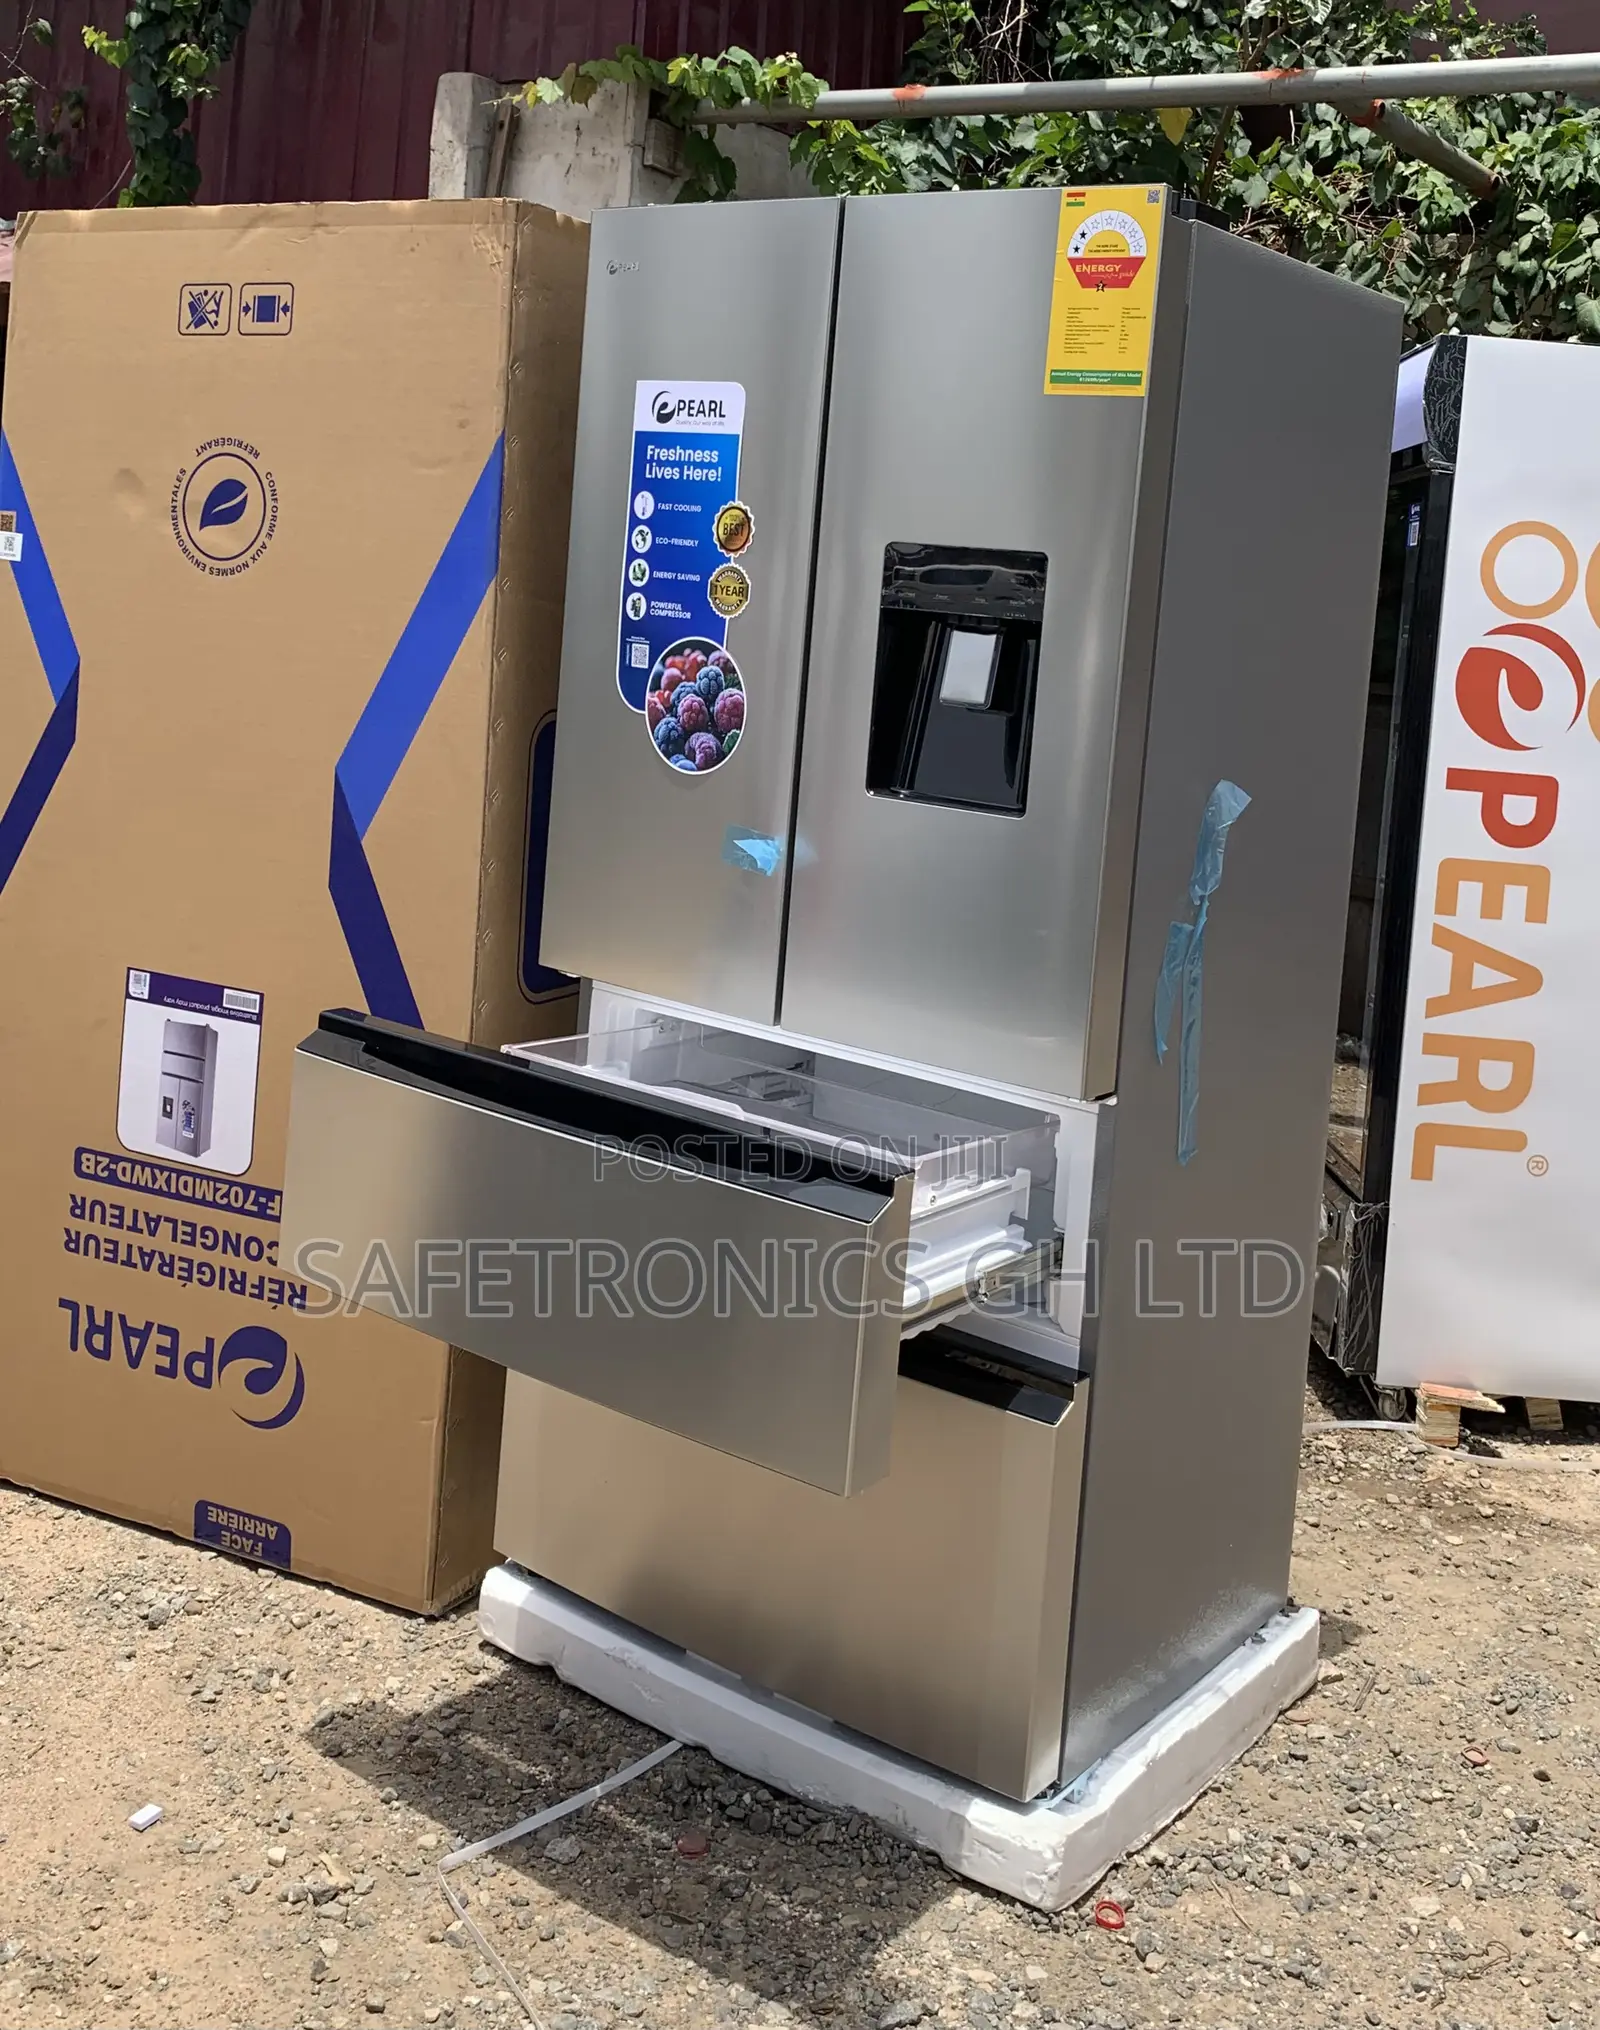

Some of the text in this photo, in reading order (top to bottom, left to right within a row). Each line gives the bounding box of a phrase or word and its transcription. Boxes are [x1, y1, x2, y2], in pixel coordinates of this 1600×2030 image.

[1075, 263, 1122, 275] ENERGY
[677, 400, 726, 418] PEARL
[195, 437, 260, 460] RÉFRIGÉRANT
[647, 445, 719, 463] Freshness
[645, 462, 722, 482] Lives Here!
[657, 502, 702, 513] FAST COOLING
[170, 467, 278, 577] CONFORME AUX NORMES ENVIRONMENTALES
[722, 522, 745, 537] BEST
[655, 536, 699, 547] ECO-FRIENDLY
[653, 571, 701, 582] ENERGY SAVING
[714, 585, 745, 598] 1 YEAR
[650, 600, 682, 611] POWERFUL
[649, 608, 692, 619] COMPRESSOR
[163, 995, 175, 1004] vary
[176, 998, 188, 1007] may
[189, 1001, 210, 1012] product
[63, 1227, 308, 1310] RÉFRIGÉRATEUR
[58, 1297, 215, 1390] PEARL
[207, 1505, 279, 1540] ARRIÈRE
[220, 1530, 263, 1557] FACE
